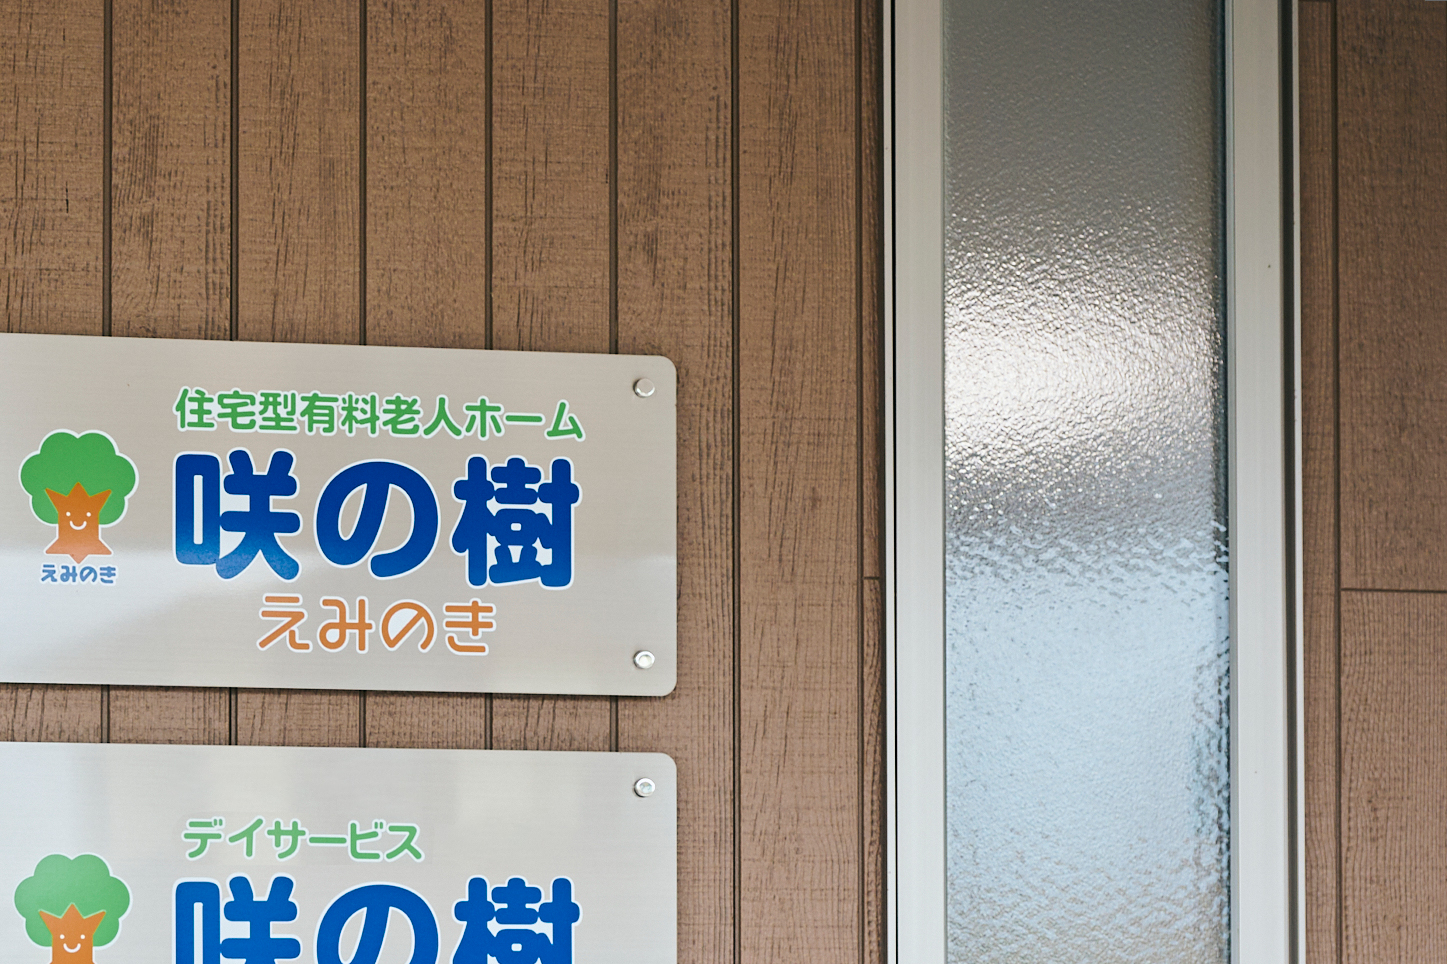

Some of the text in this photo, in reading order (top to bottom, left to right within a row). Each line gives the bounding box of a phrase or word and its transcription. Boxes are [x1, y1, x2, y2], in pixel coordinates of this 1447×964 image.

[173, 387, 584, 439] 住宅型有料老人ホーム
[173, 448, 581, 589] 咲の樹
[38, 563, 117, 584] えみのき
[257, 594, 496, 655] えみのき
[182, 816, 424, 861] デイサービス
